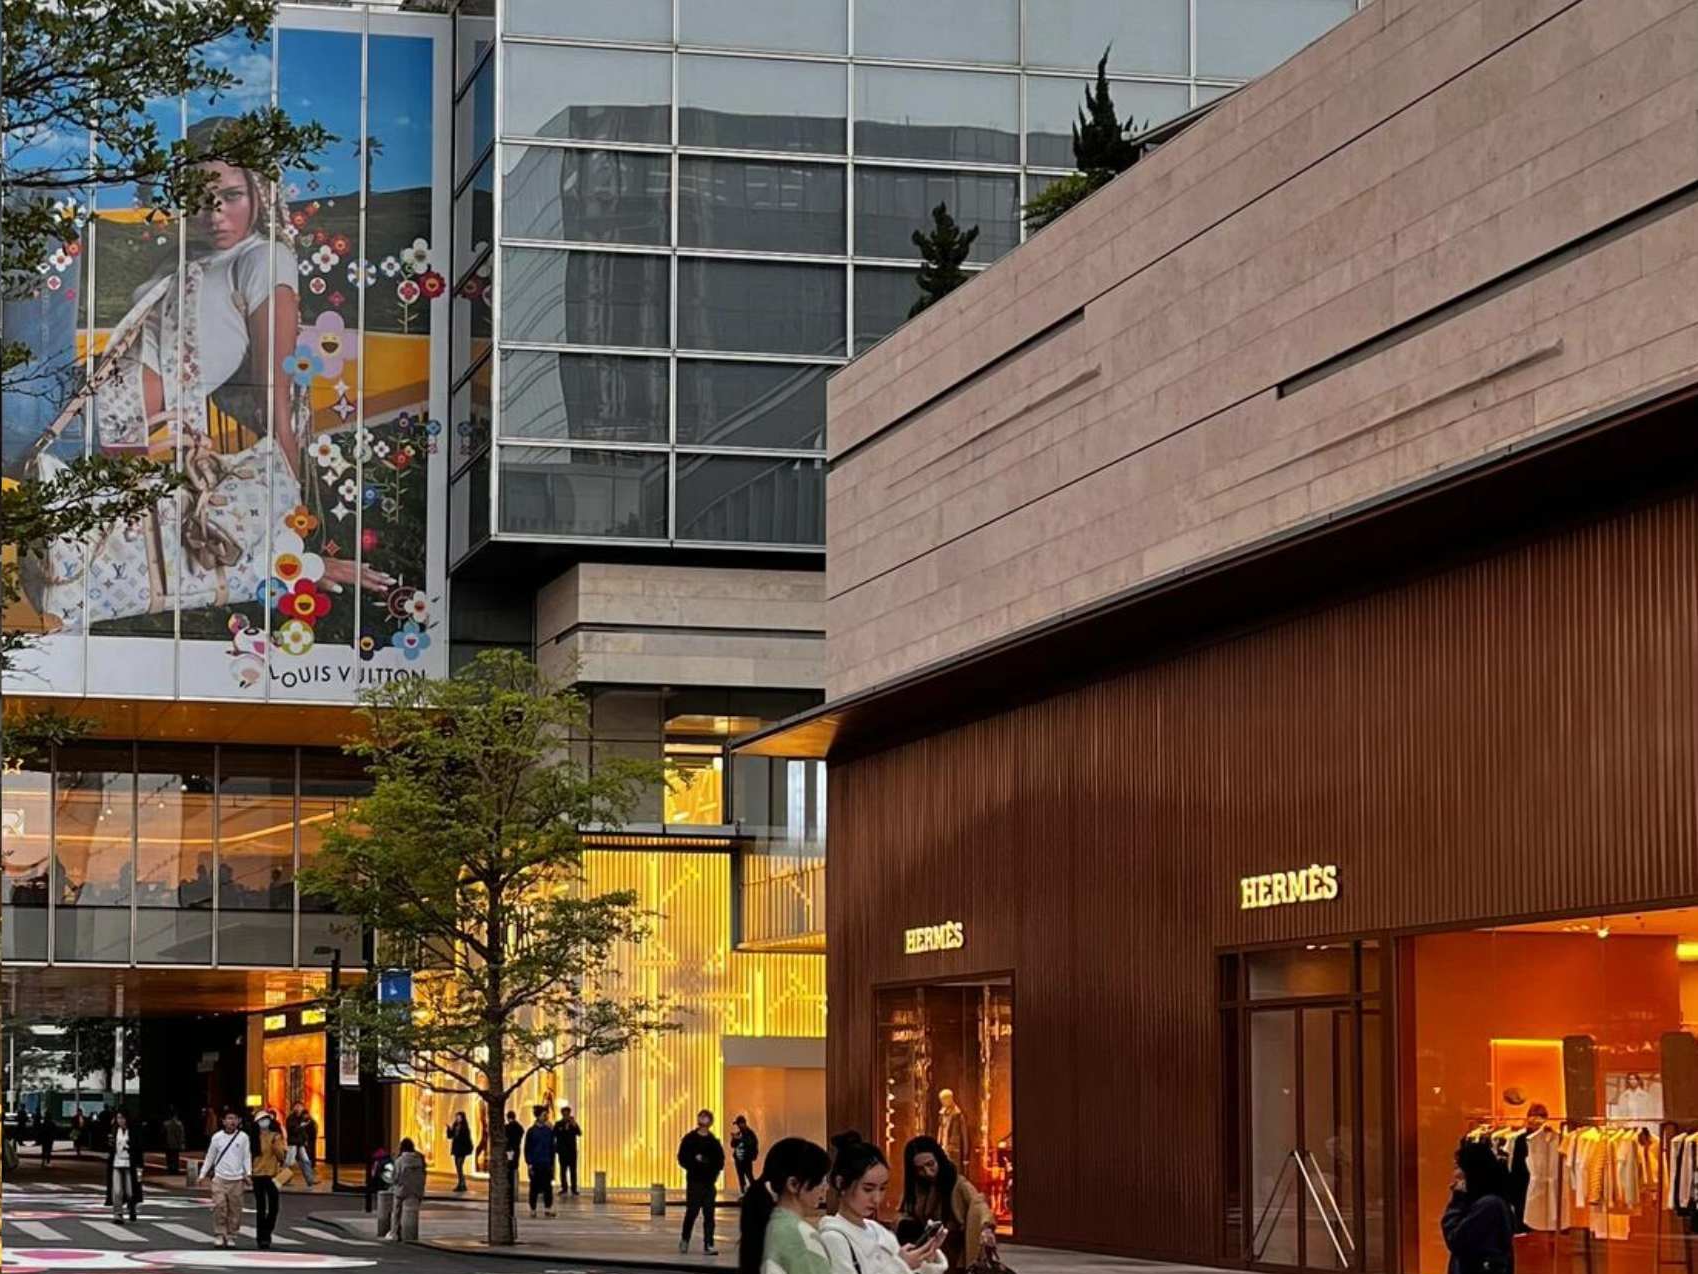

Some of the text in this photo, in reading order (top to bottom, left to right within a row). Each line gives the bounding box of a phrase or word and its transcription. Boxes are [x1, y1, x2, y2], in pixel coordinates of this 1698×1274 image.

[269, 664, 331, 688] LOUIS
[1241, 864, 1338, 909] HERMÈS
[905, 921, 964, 954] HERMÈS
